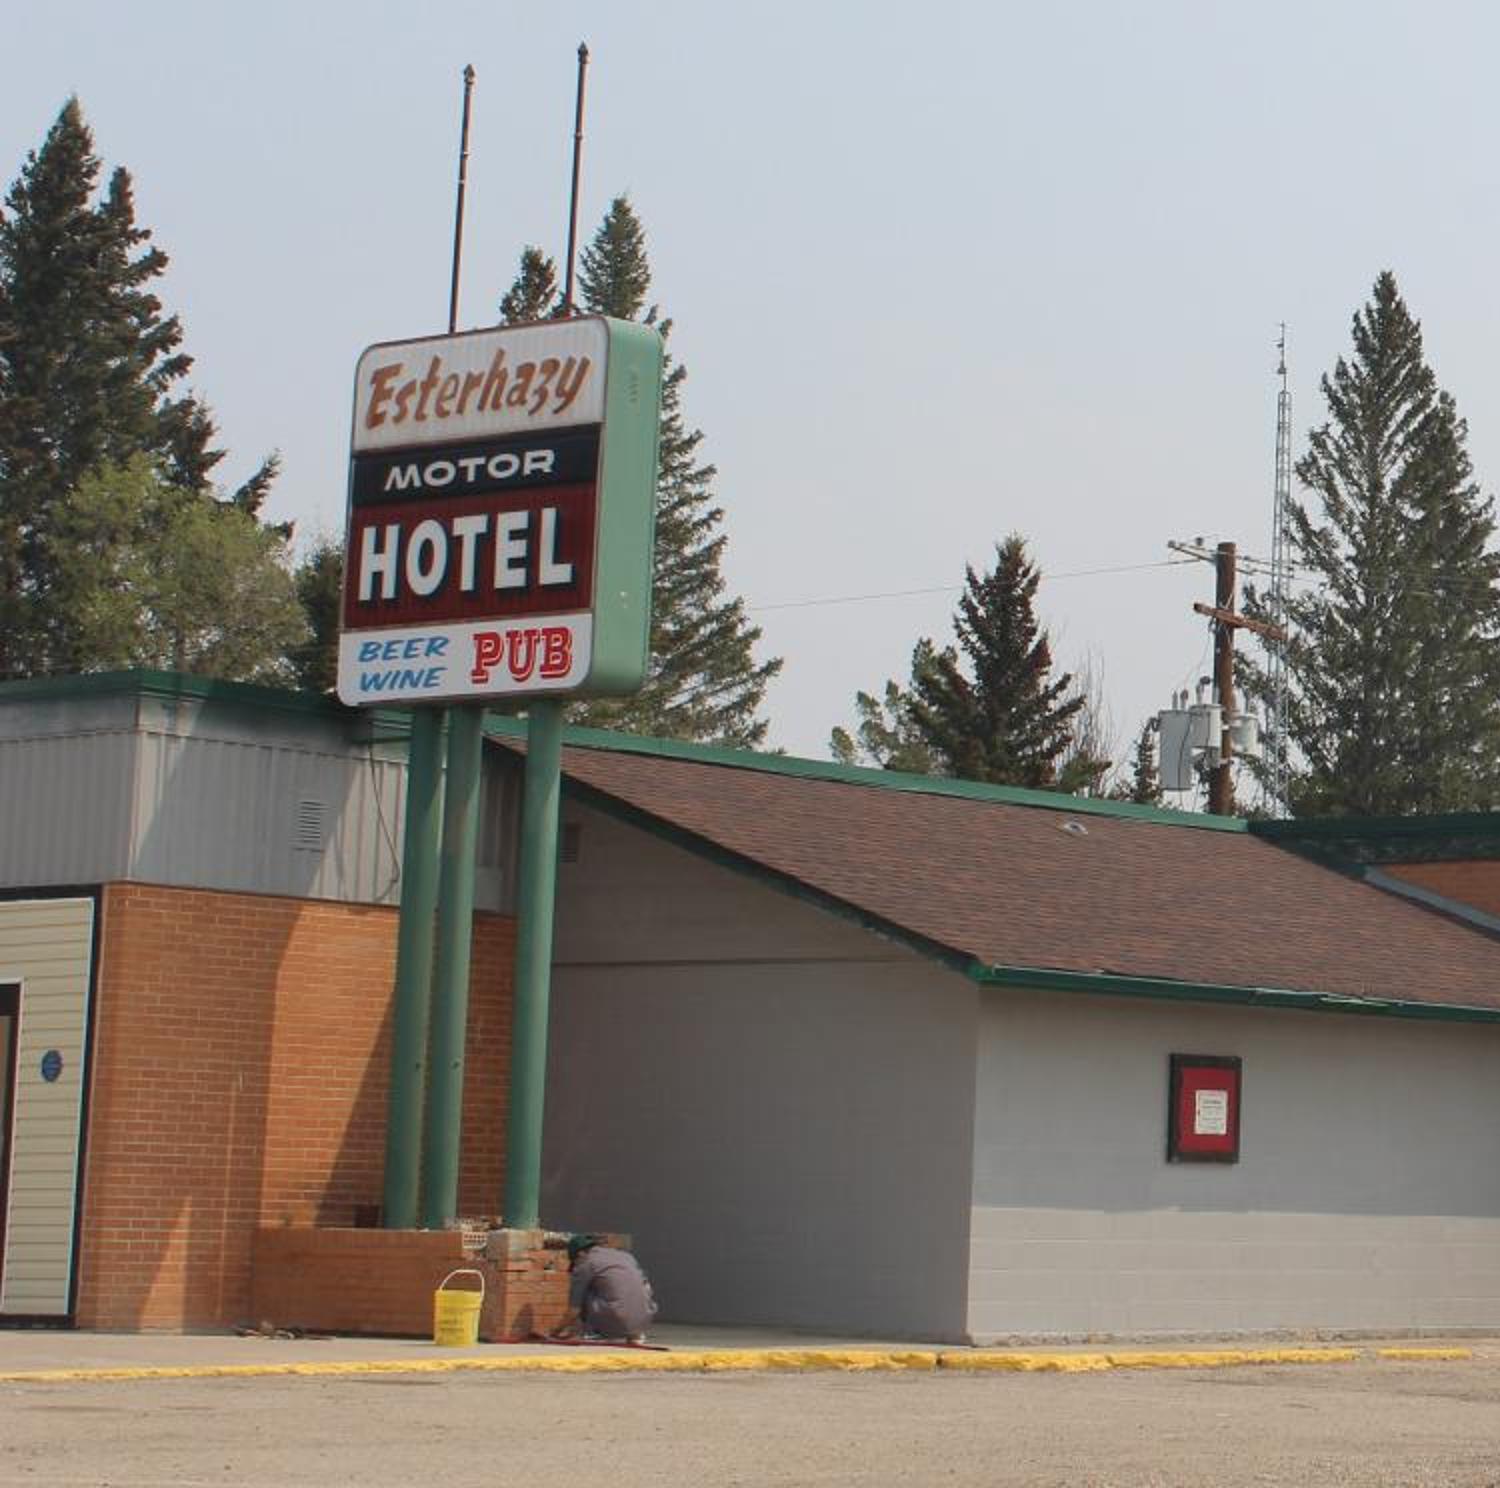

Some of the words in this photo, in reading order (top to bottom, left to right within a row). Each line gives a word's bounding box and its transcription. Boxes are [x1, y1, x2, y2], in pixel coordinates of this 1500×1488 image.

[364, 348, 592, 431] Esterhazy
[384, 449, 556, 492] MOTOR
[358, 507, 573, 601] HOTEL
[358, 635, 450, 663] BEER
[471, 626, 573, 684] PUB
[358, 666, 447, 692] WINE
